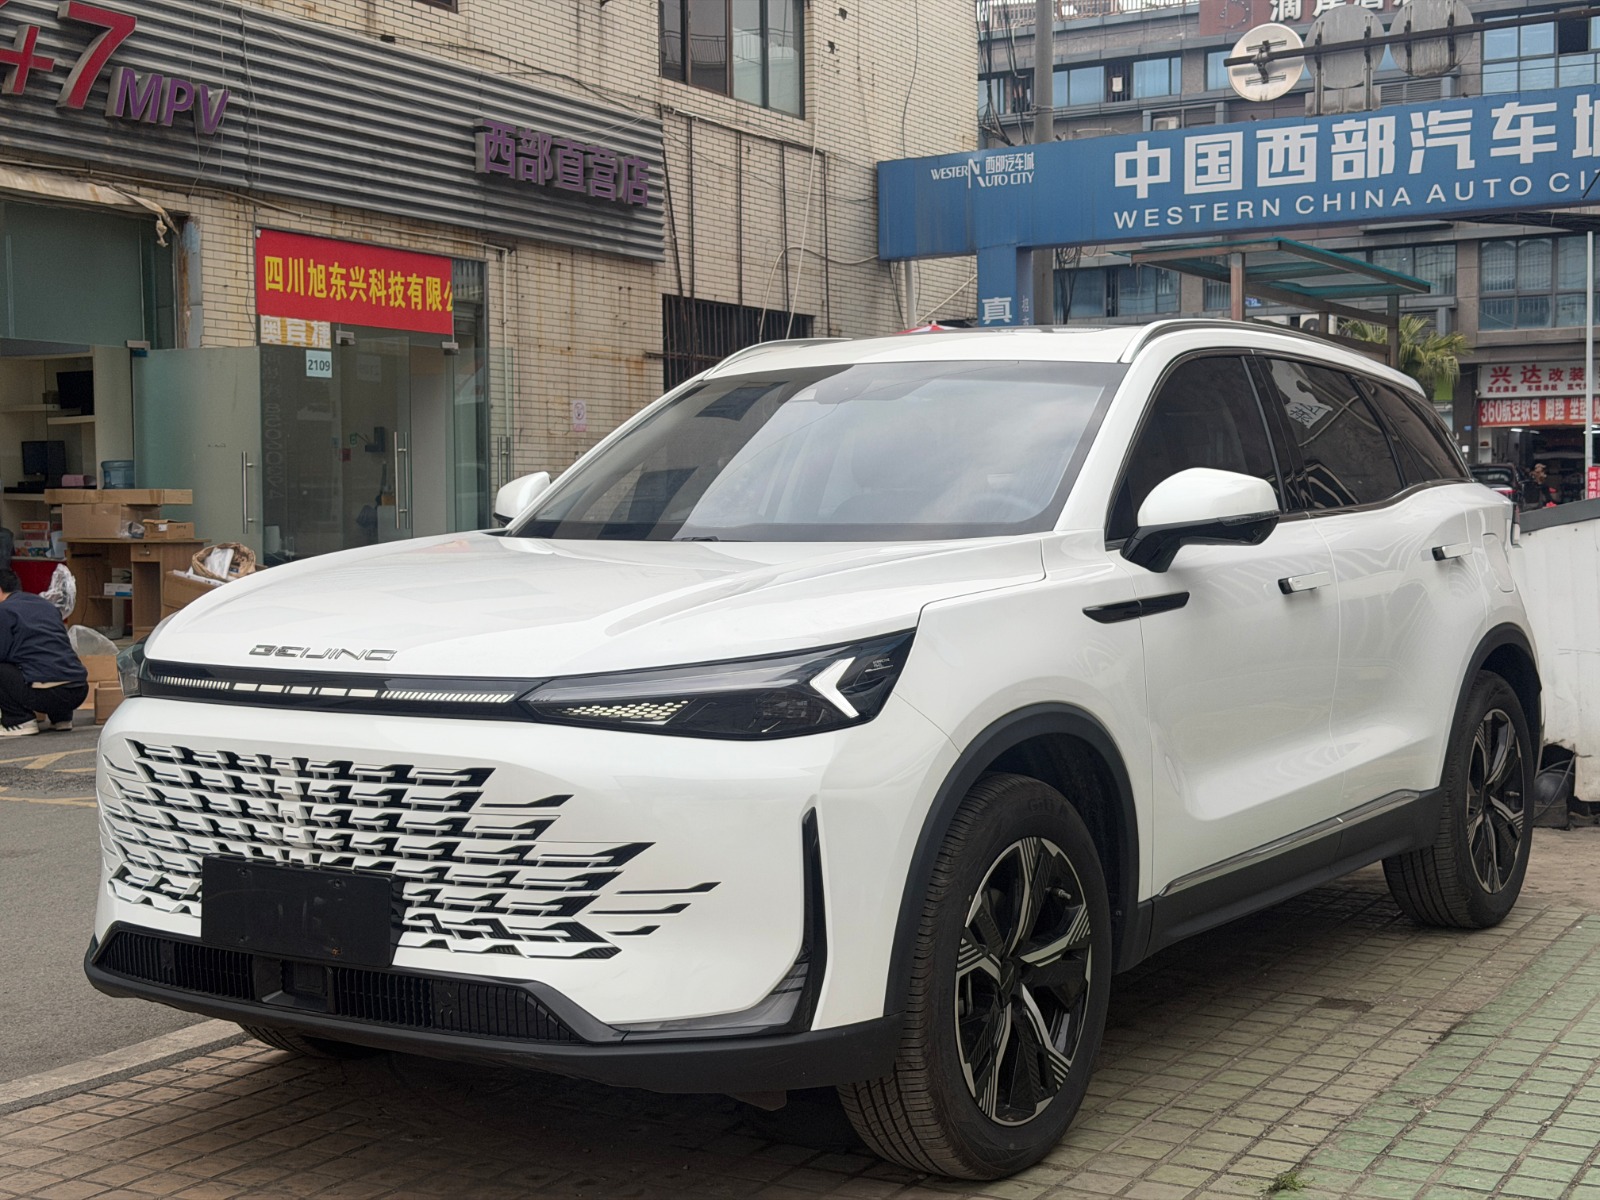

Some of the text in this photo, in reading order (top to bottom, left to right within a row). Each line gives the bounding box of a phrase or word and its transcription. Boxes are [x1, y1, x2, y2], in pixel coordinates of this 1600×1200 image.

[0, 0, 231, 136] +7 MPV
[478, 118, 649, 208] 西部直营店
[986, 152, 1034, 174] 西部汽车城
[1010, 172, 1034, 184] CITY
[1114, 169, 1600, 229] WESTERN CHINA AUTO CI
[308, 359, 331, 371] 2109
[249, 644, 398, 662] BEIJING
